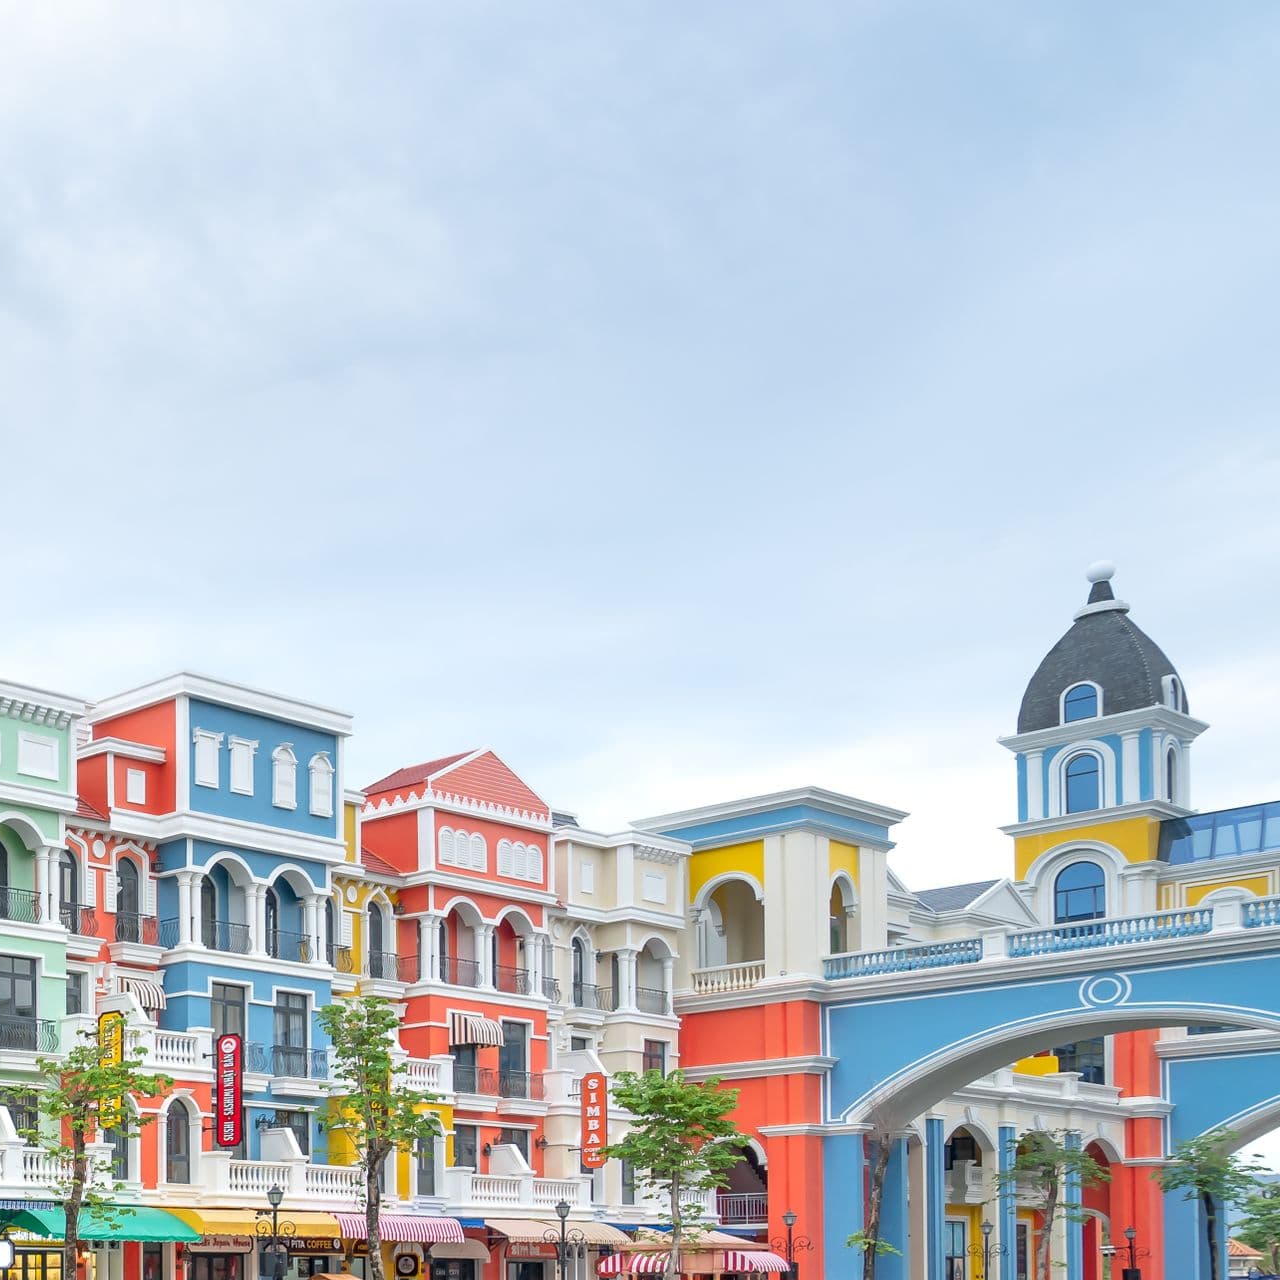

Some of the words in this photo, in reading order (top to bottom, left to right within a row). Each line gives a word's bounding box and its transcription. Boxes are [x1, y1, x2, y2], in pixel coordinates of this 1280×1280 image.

[221, 1069, 237, 1087] NHẬT
[223, 1088, 234, 1115] SASHIMI
[586, 1078, 600, 1144] SIMBA
[223, 1121, 234, 1141] SUSHI
[292, 1239, 305, 1249] PITA
[306, 1240, 333, 1249] COFFEE
